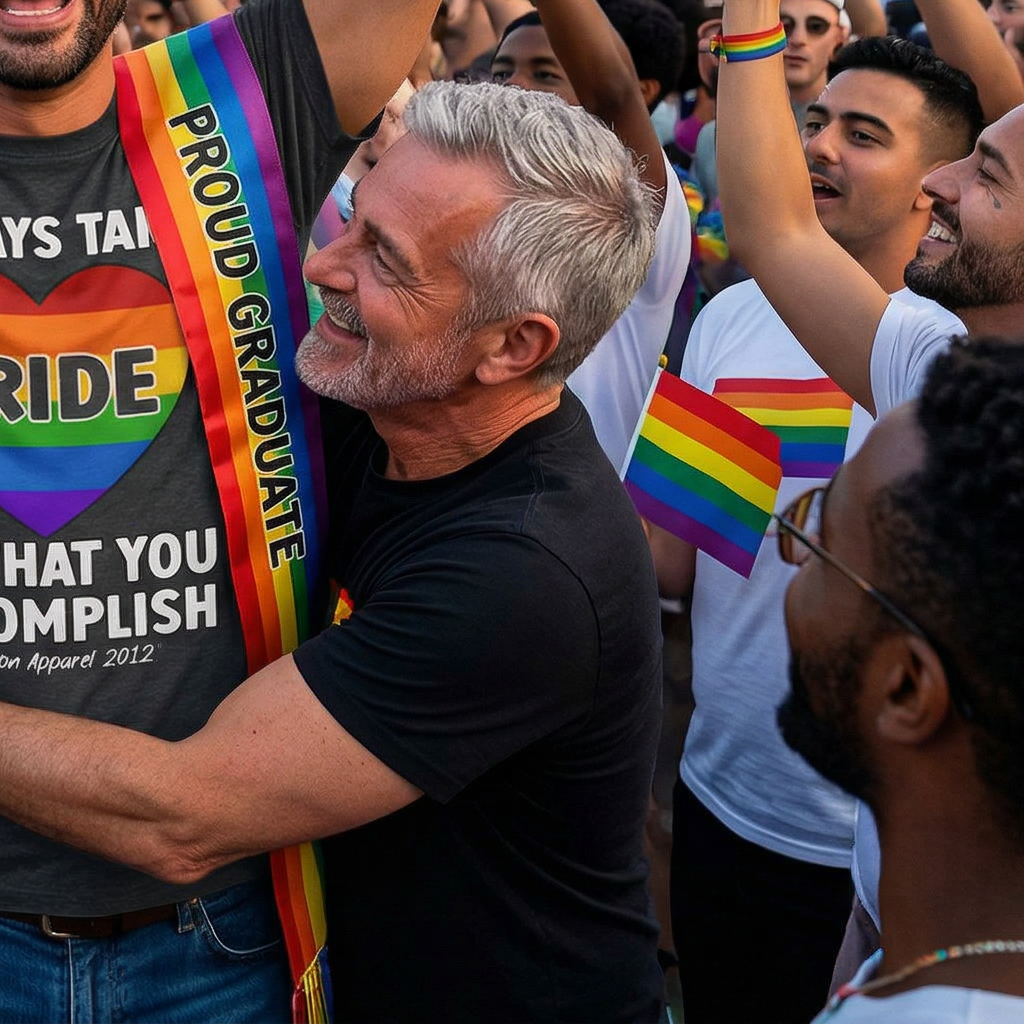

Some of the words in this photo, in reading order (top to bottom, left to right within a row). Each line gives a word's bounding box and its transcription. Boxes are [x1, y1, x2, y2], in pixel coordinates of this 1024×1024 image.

[166, 103, 260, 280] PROUD
[227, 292, 306, 570] GRADUATE
[116, 527, 218, 582] YOU
[26, 650, 98, 676] Apparel
[102, 643, 155, 668] 2012
